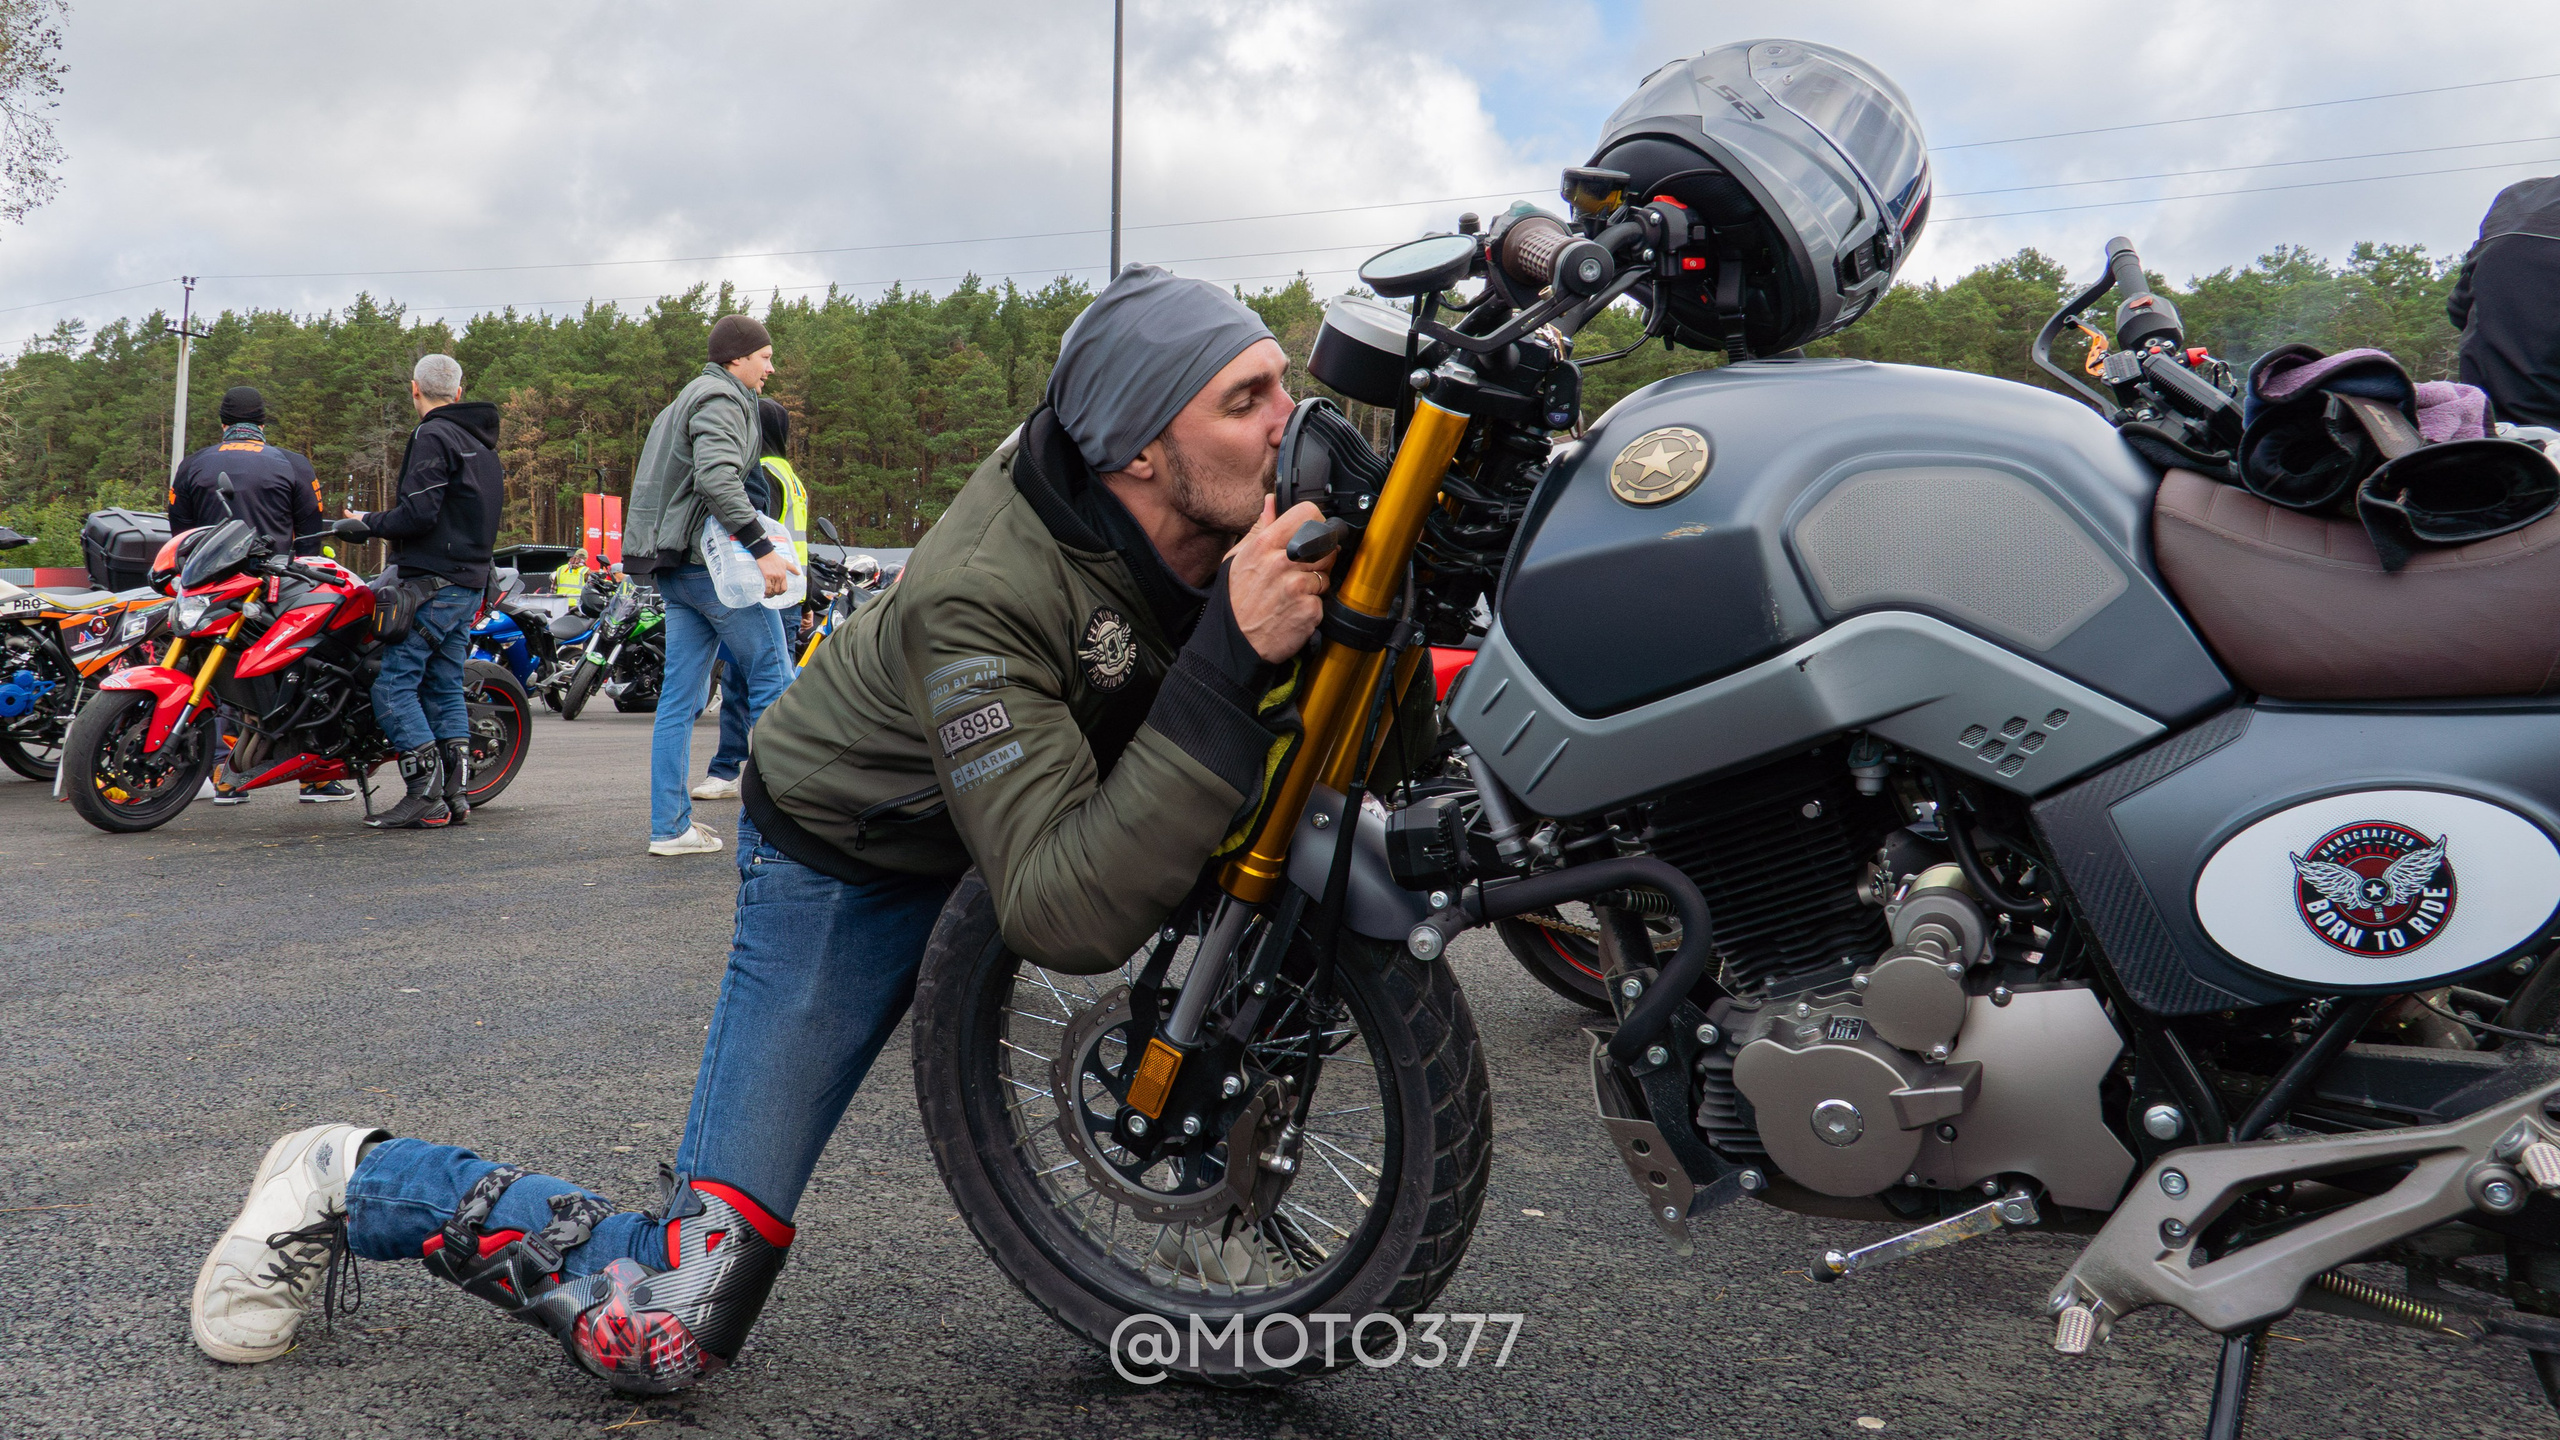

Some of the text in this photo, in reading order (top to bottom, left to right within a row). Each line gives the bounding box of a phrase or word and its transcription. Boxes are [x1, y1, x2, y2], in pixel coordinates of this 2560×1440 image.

[1695, 75, 1766, 122] LS2
[13, 599, 41, 611] PRO
[1088, 643, 1137, 688] FASHION CLUB
[953, 675, 968, 688] BY
[974, 669, 998, 681] AIR
[402, 759, 418, 778] G
[980, 745, 1018, 771] ARMY
[269, 760, 318, 784] SUZUKI
[2319, 829, 2415, 857] HANDCRAFTED
[2337, 846, 2400, 864] GENUINE
[2306, 887, 2448, 950] BORN TO RIDE
